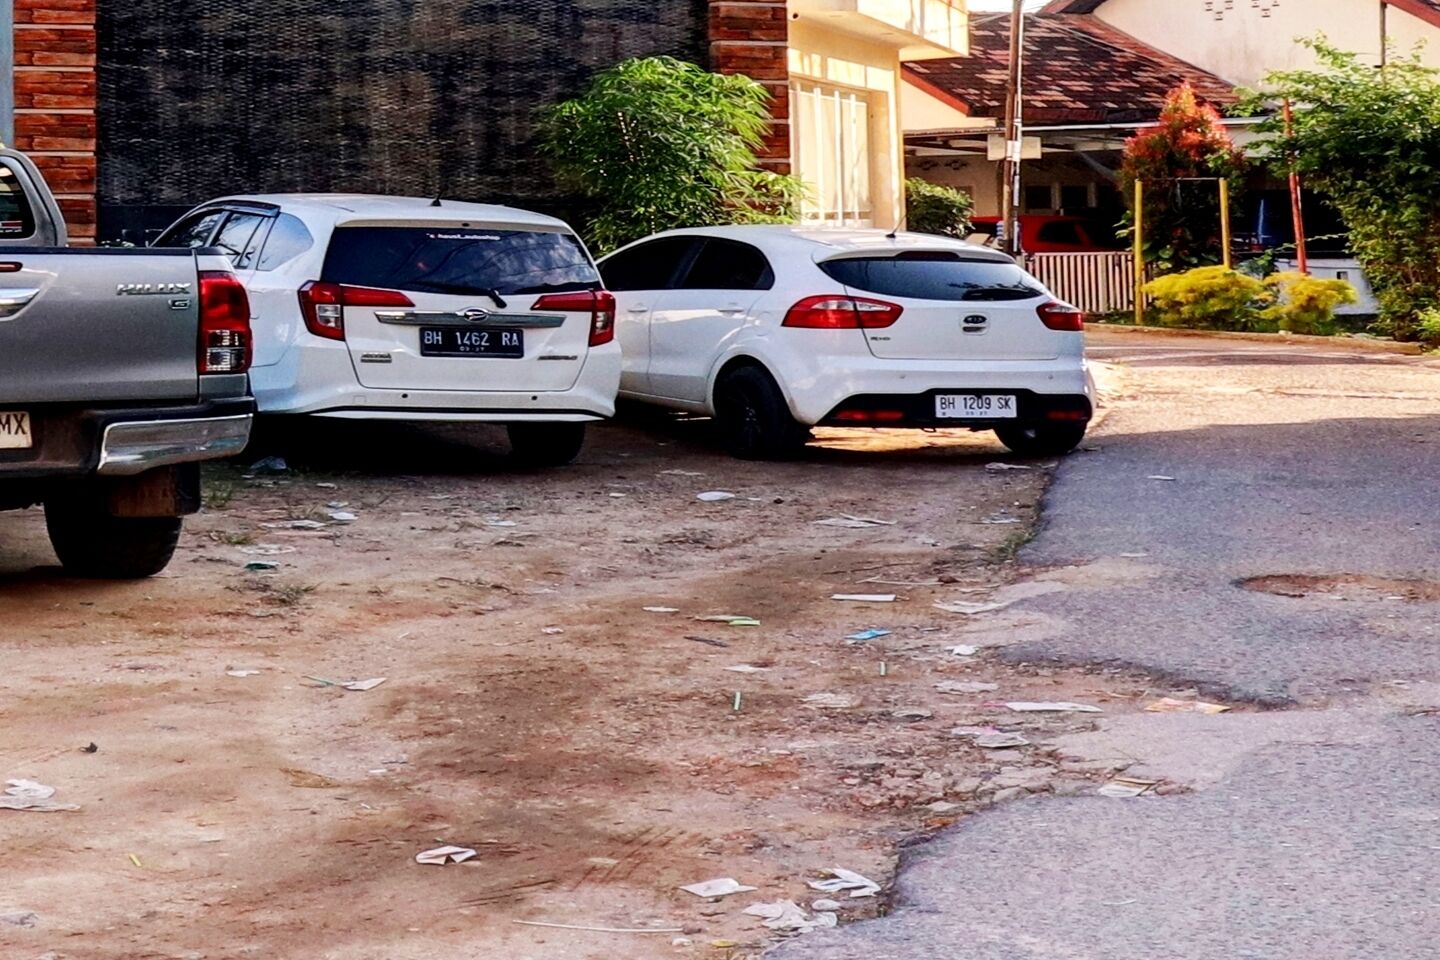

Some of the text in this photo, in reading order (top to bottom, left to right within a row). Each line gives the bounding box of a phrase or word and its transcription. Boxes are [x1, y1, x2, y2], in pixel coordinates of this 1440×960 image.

[116, 283, 192, 296] HILUX
[424, 331, 519, 346] BH 1462 RA
[940, 397, 1012, 410] BH 1209 SK
